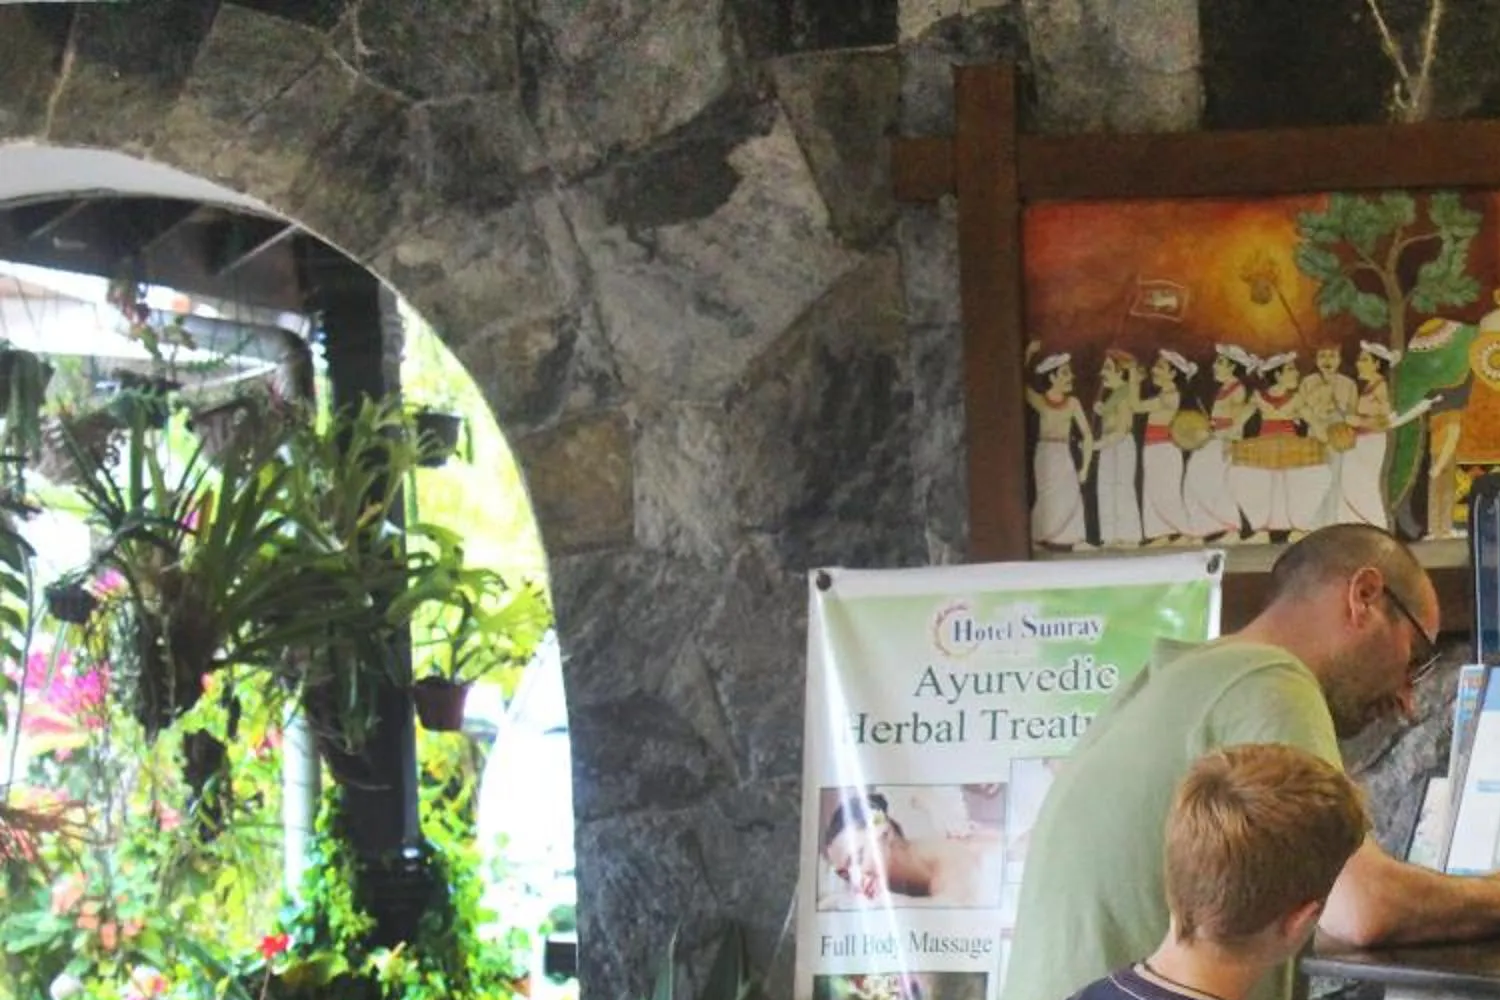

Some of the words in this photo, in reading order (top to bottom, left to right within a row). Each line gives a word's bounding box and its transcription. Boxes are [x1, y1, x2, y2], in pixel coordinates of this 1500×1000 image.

[953, 617, 1013, 643] Hotel
[1020, 614, 1103, 644] Sunray
[913, 658, 1118, 704] Ayurvedic
[980, 707, 1093, 742] Treat
[820, 934, 856, 957] Full
[908, 930, 993, 959] Massage
